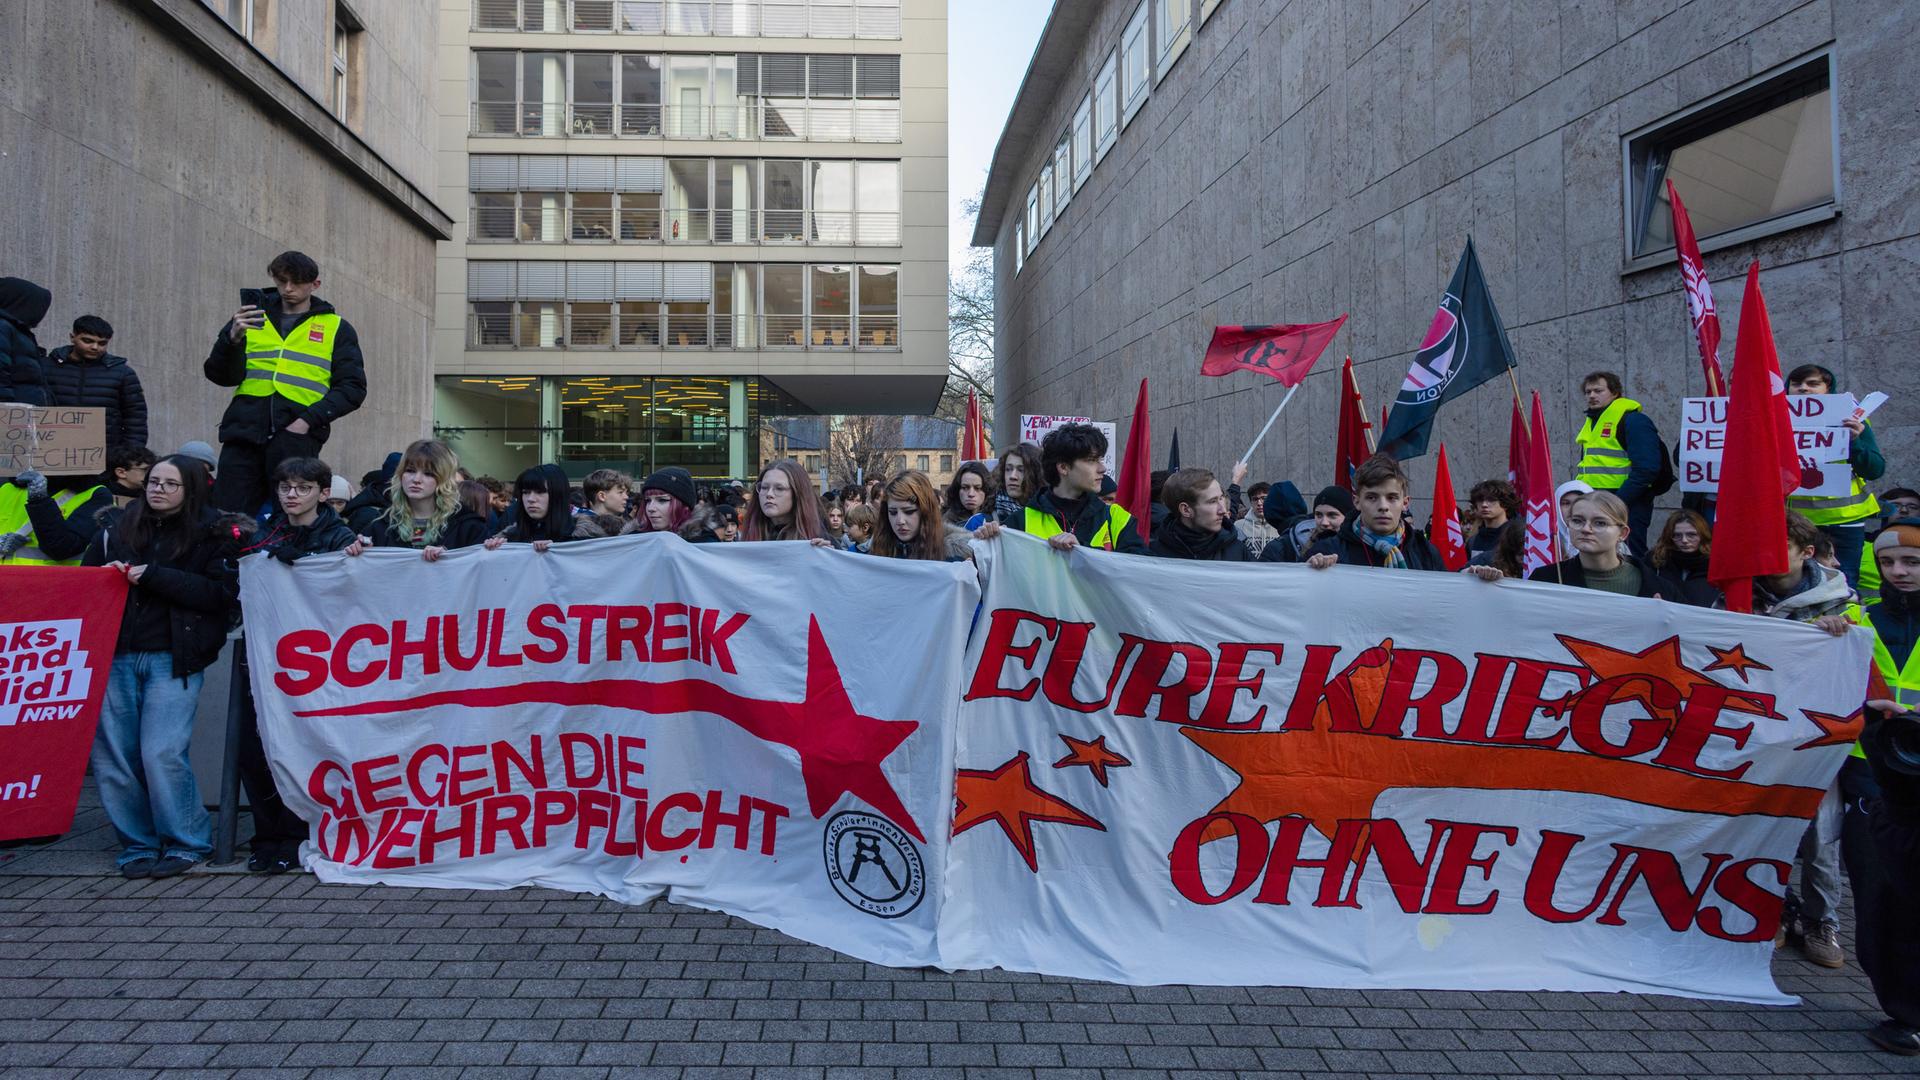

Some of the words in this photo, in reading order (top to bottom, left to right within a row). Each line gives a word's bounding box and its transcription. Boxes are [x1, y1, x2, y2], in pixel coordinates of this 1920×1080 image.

[1688, 398, 1824, 423] JUND
[6, 428, 56, 441] OHNE
[0, 626, 58, 652] ks
[274, 603, 752, 696] SCHULSTREIK
[963, 608, 1283, 730] EURE
[1279, 643, 1776, 780] KRIEGE
[22, 704, 84, 723] NRW
[0, 774, 42, 801] n!
[308, 740, 548, 820] GEGEN
[559, 733, 648, 799] DIE
[318, 789, 790, 869] WEHRPFLICHT
[1170, 813, 1518, 914] OHNE
[1524, 829, 1794, 942] UNS
[860, 899, 895, 912] Essen
